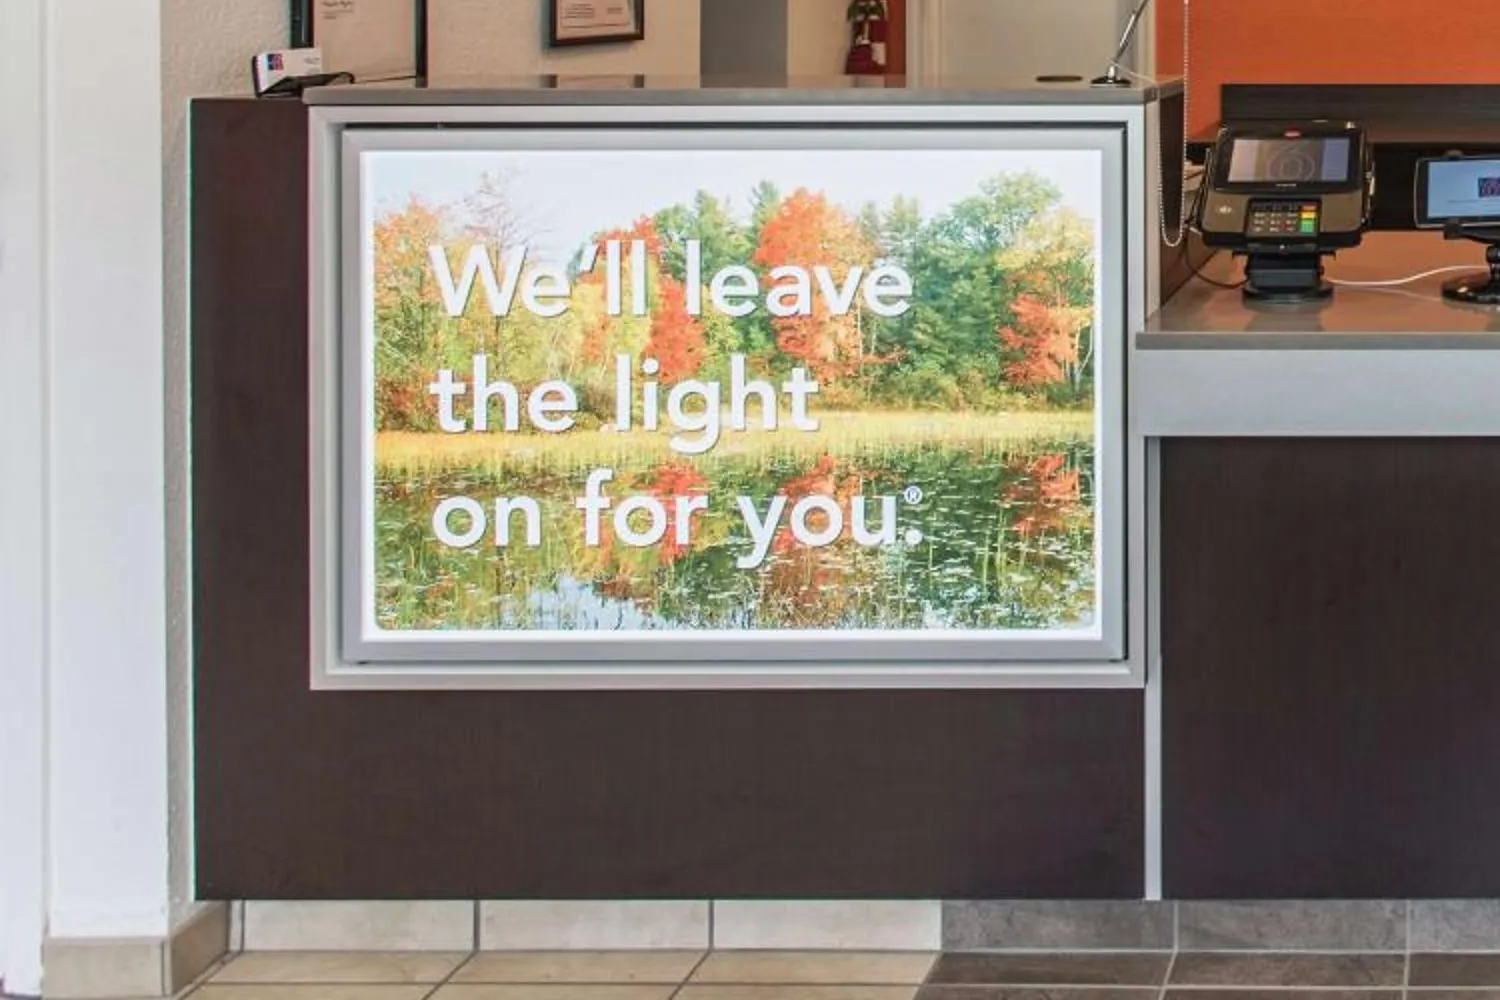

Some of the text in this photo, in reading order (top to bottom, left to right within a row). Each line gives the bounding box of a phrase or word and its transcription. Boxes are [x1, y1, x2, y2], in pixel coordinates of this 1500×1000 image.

[429, 239, 913, 318] We'll leave
[429, 353, 820, 456] the light
[432, 493, 541, 548] on
[576, 468, 708, 548] for
